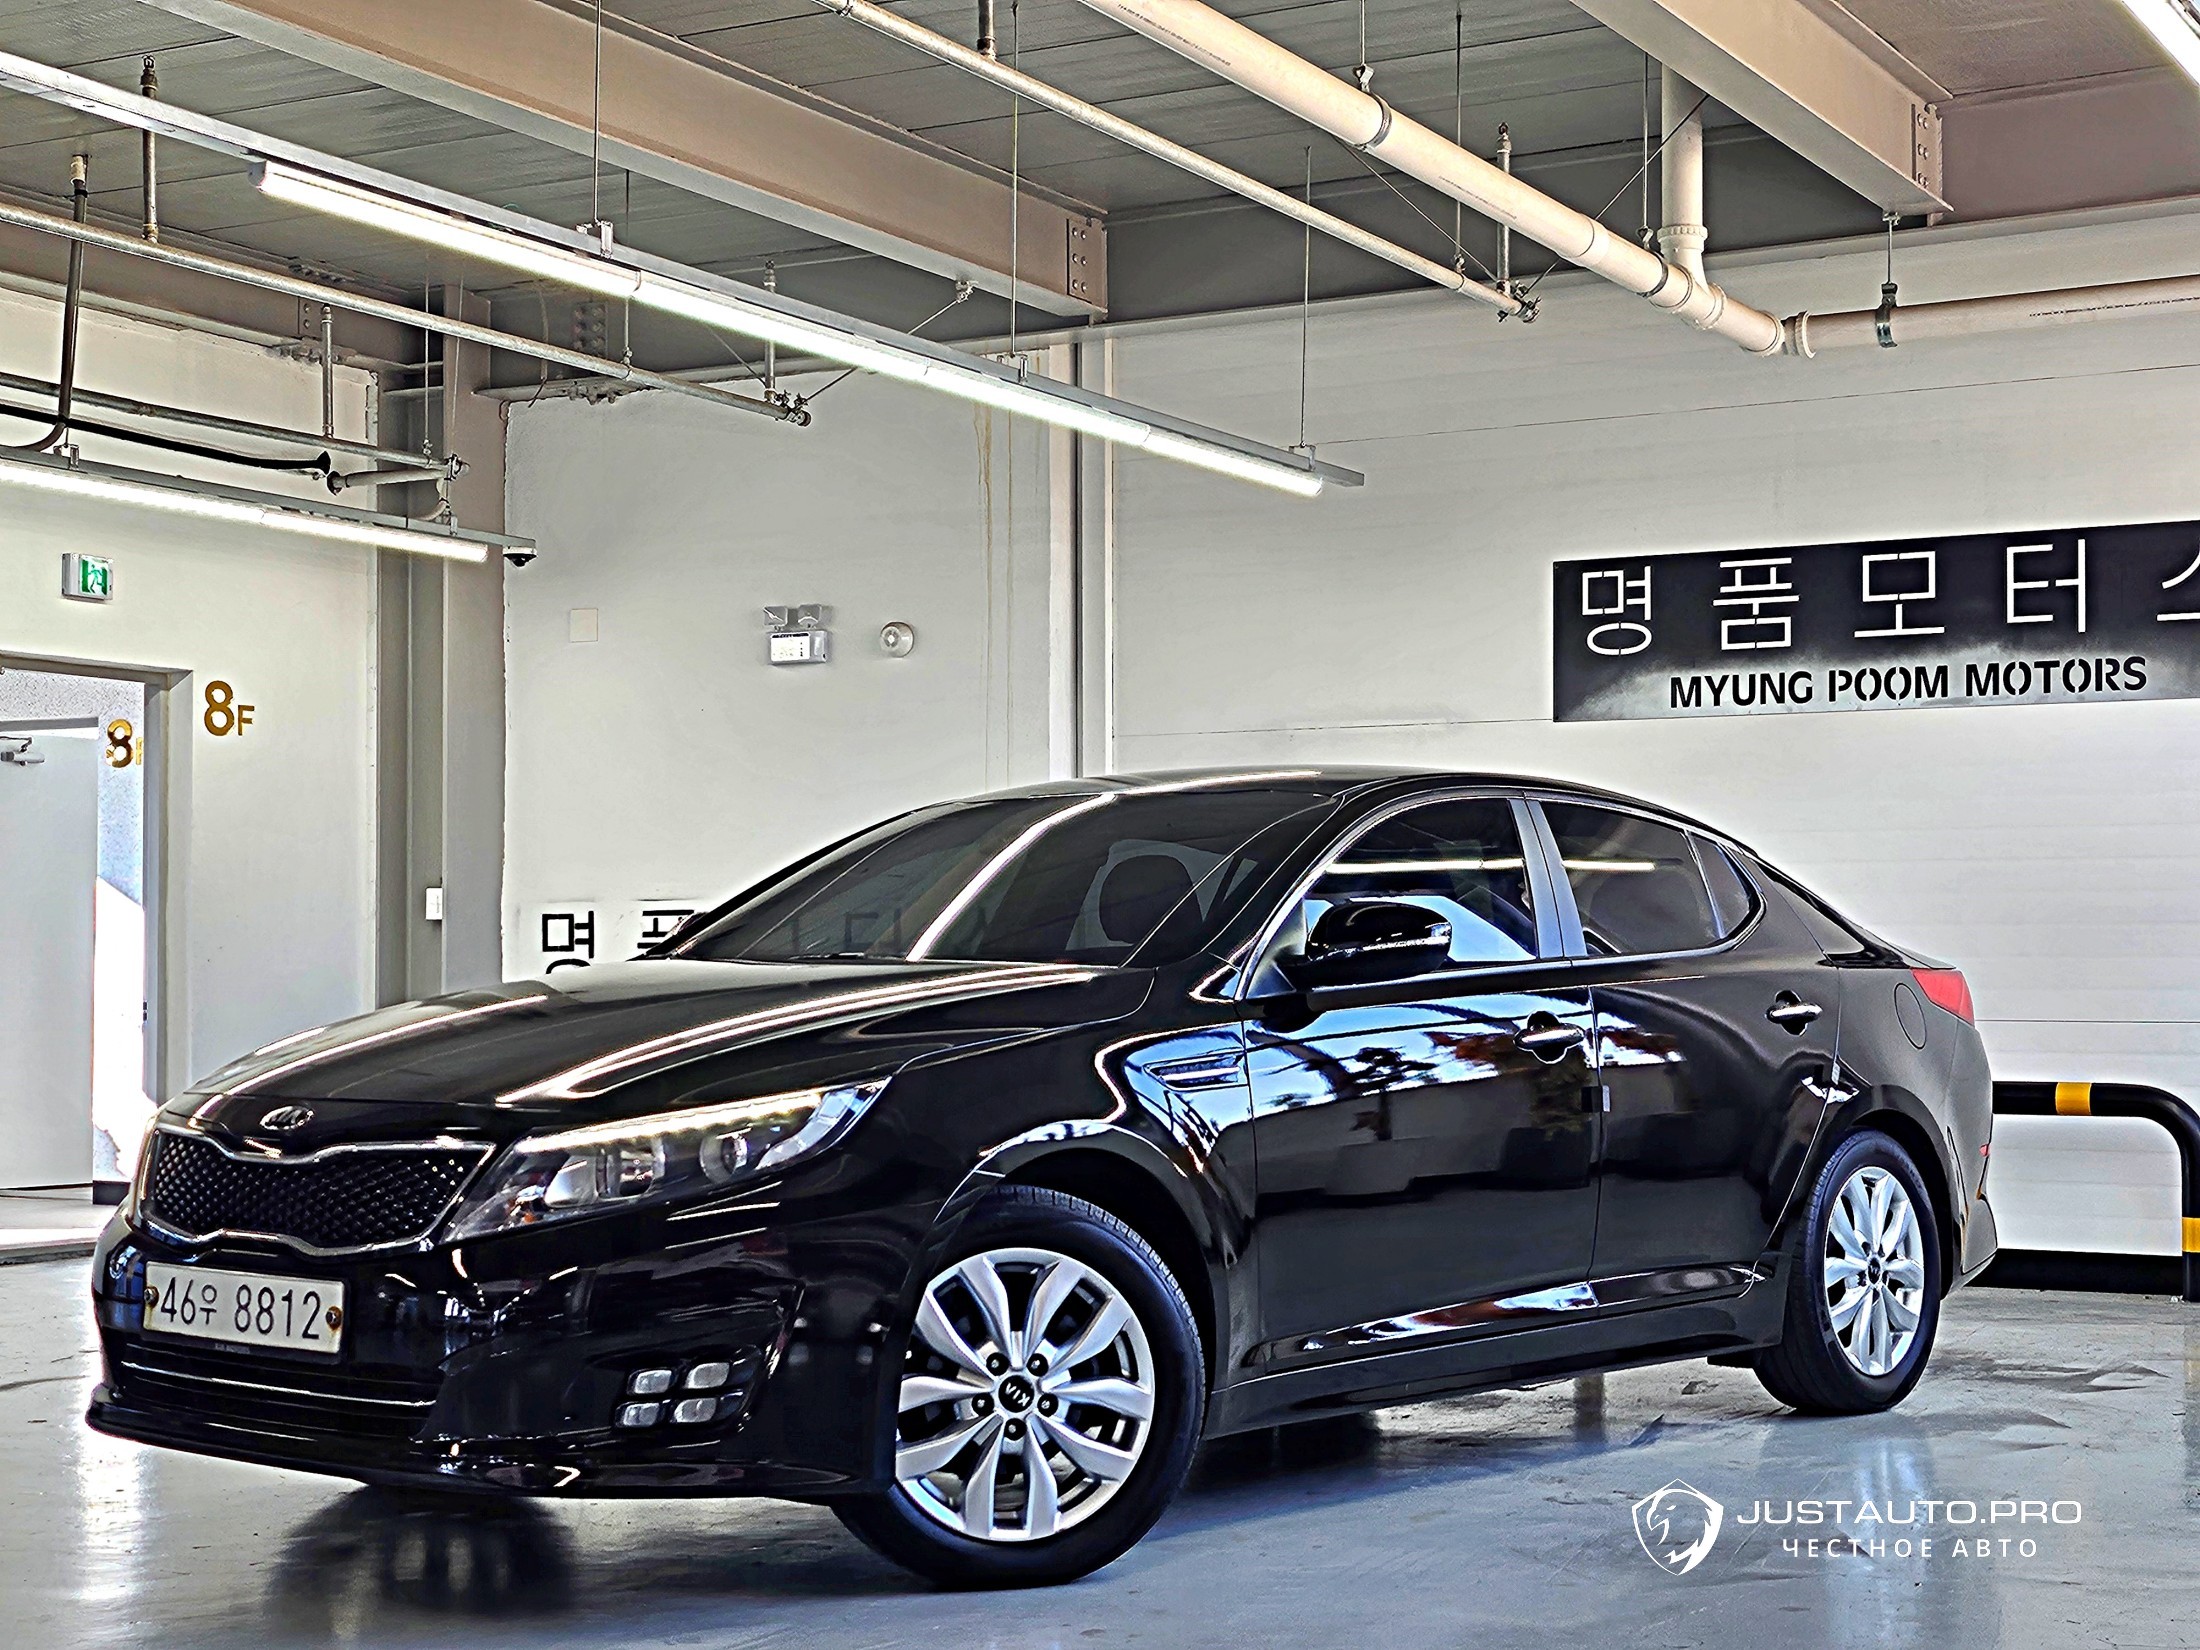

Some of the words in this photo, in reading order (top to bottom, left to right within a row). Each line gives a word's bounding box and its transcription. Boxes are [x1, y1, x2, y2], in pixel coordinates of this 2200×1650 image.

[204, 680, 255, 736] 8F
[1669, 668, 1814, 709] MYUNG
[1827, 664, 1949, 703] POOM
[1964, 655, 2149, 697] MOTORS
[160, 1276, 218, 1327] 46우
[233, 1283, 322, 1340] 8812
[1004, 1381, 1031, 1407] KIA
